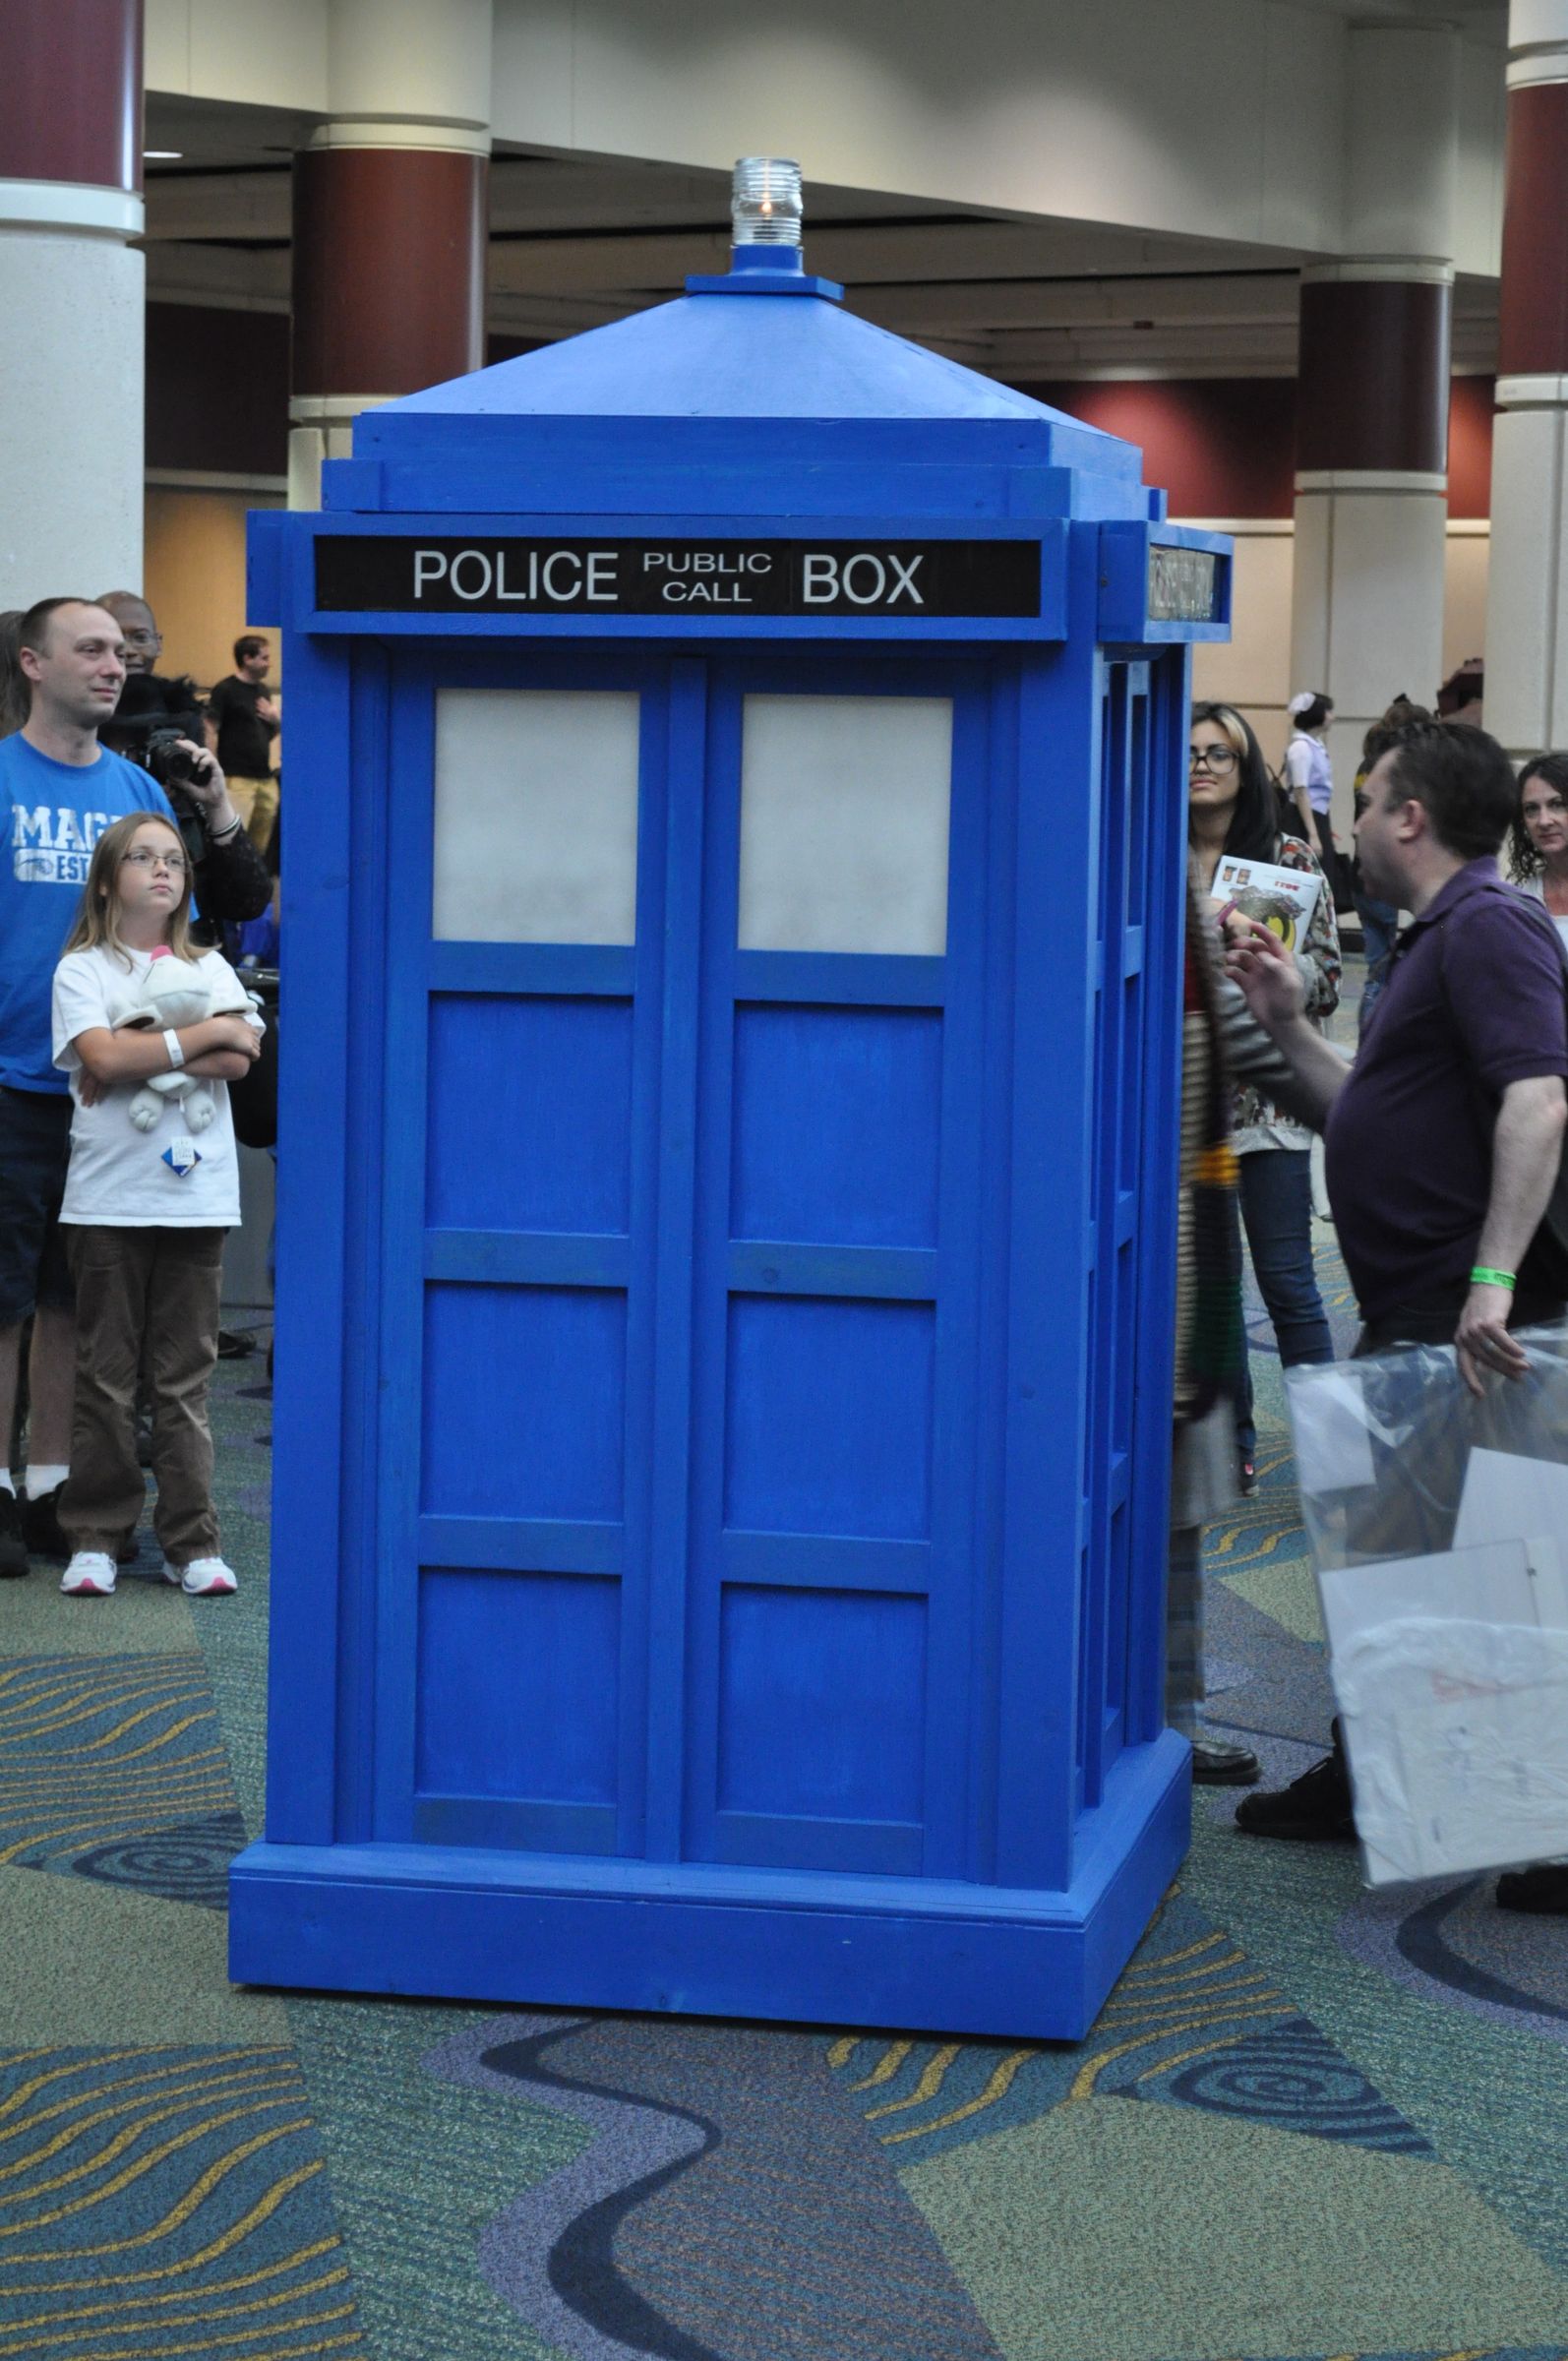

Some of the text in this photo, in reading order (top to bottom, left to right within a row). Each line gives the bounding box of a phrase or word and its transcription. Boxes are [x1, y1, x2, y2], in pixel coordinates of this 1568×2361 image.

[413, 550, 925, 605] POLICE PUBLIC CALL BOX
[12, 805, 123, 853] MAG
